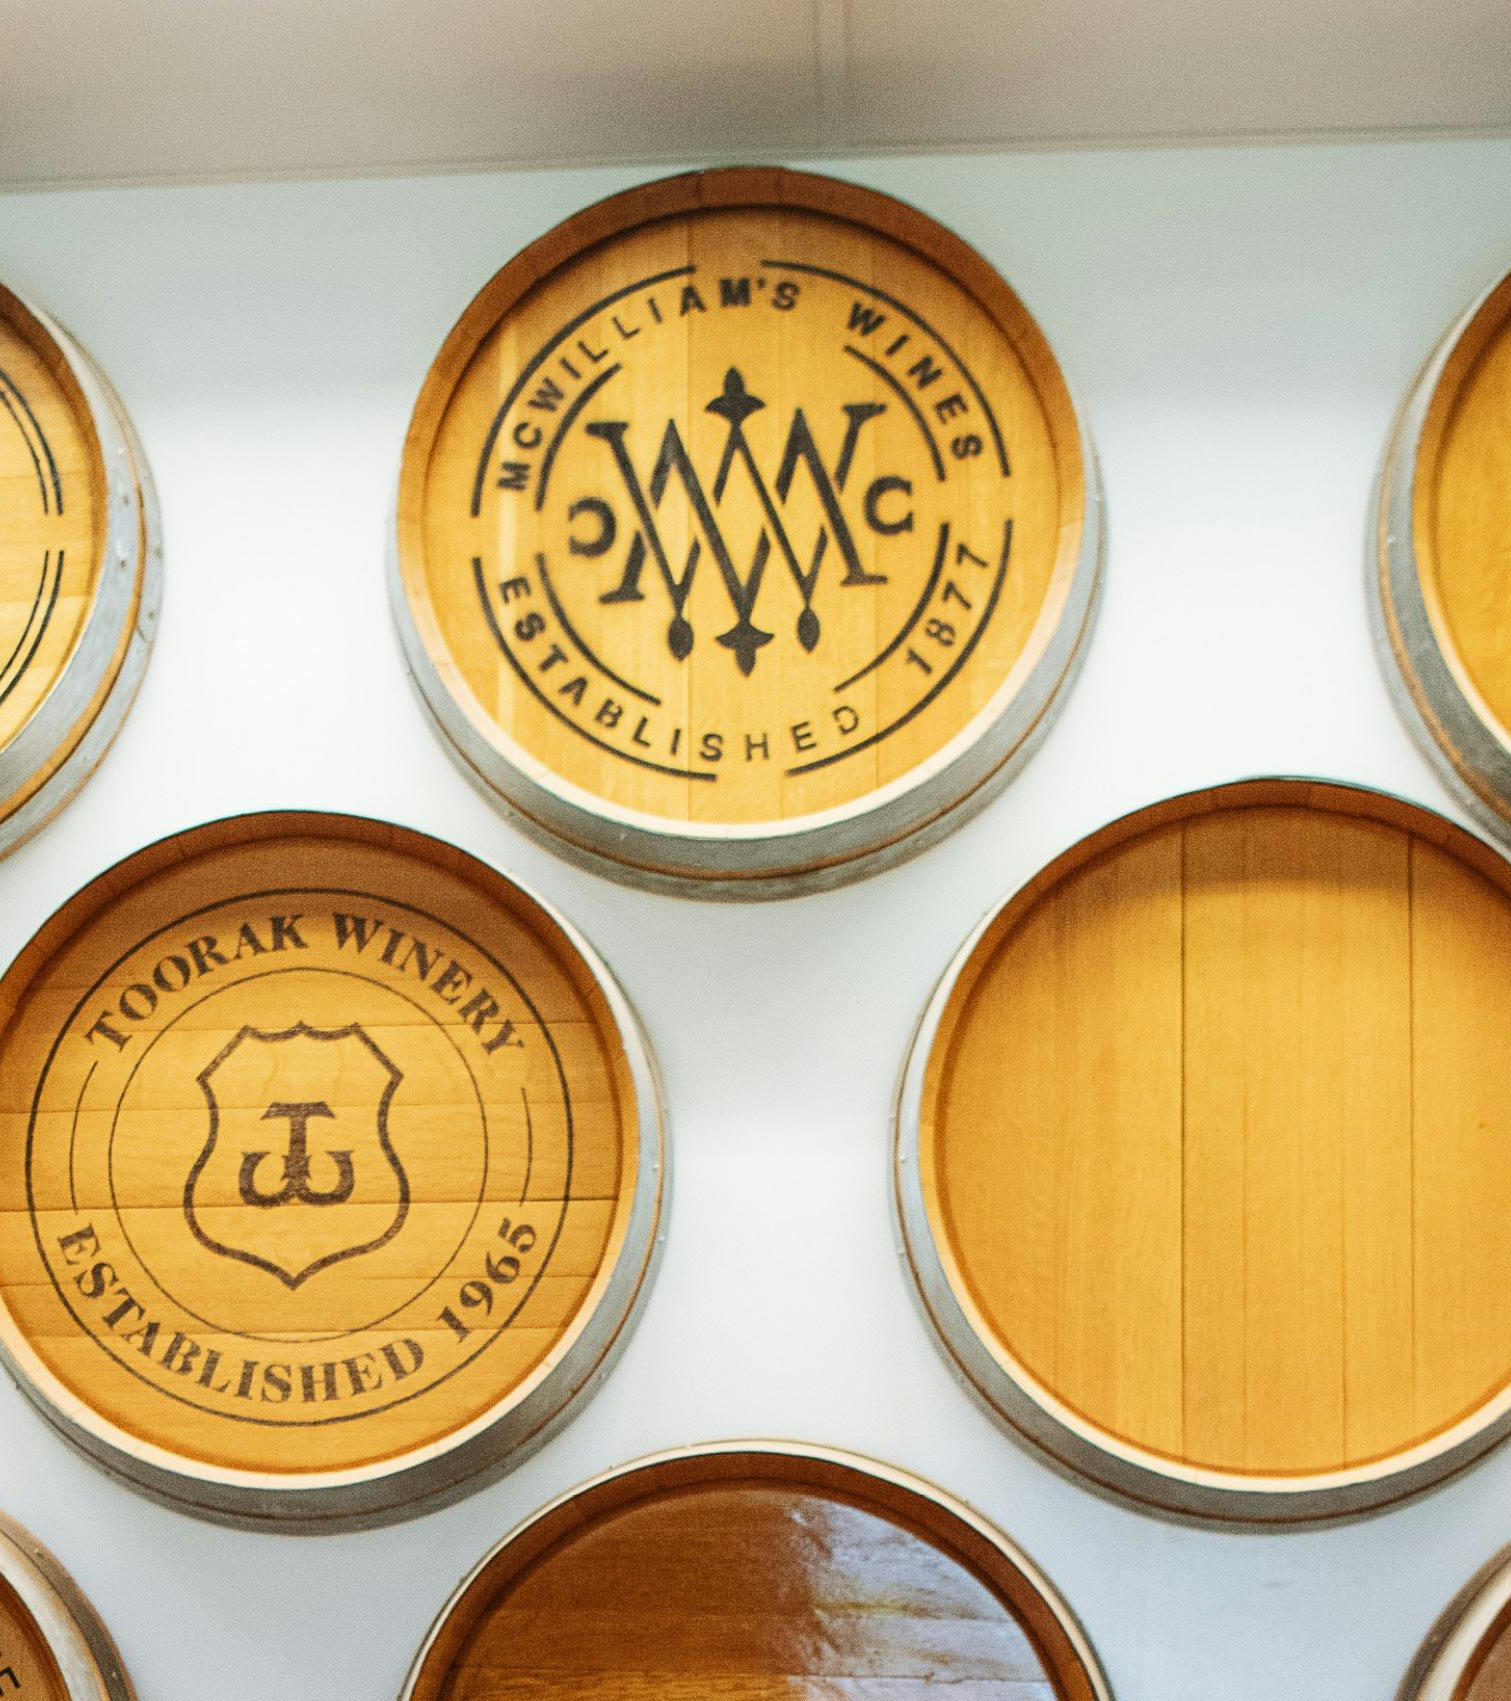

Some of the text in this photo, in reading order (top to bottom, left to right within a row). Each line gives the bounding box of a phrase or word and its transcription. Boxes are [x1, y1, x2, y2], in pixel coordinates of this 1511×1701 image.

[845, 301, 983, 461] WINES
[498, 544, 990, 762] ESTABLISHED 1877
[86, 911, 525, 1057] TOORAK WINERY
[57, 1215, 538, 1404] ESTABLISHED 1965
